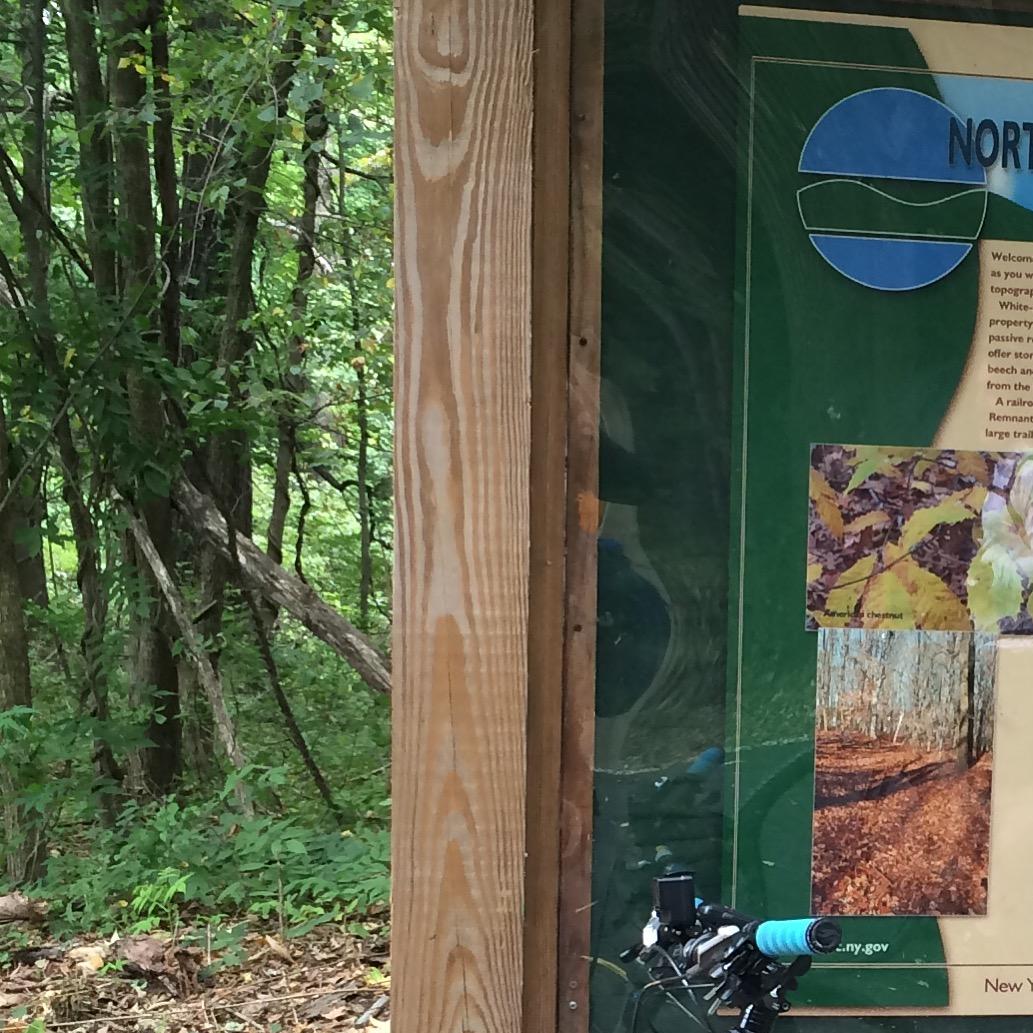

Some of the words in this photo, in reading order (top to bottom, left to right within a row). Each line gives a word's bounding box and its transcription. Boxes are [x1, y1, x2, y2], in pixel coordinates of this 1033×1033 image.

[990, 270, 1001, 278] as
[1004, 271, 1022, 281] you
[988, 348, 1011, 359] offer
[988, 364, 1017, 375] beech
[986, 380, 1010, 391] from
[1014, 381, 1030, 391] the
[995, 396, 1003, 406] A
[985, 428, 1010, 440] large
[1013, 429, 1033, 439] trail
[867, 610, 904, 619] chestnut
[984, 978, 1023, 993] New
